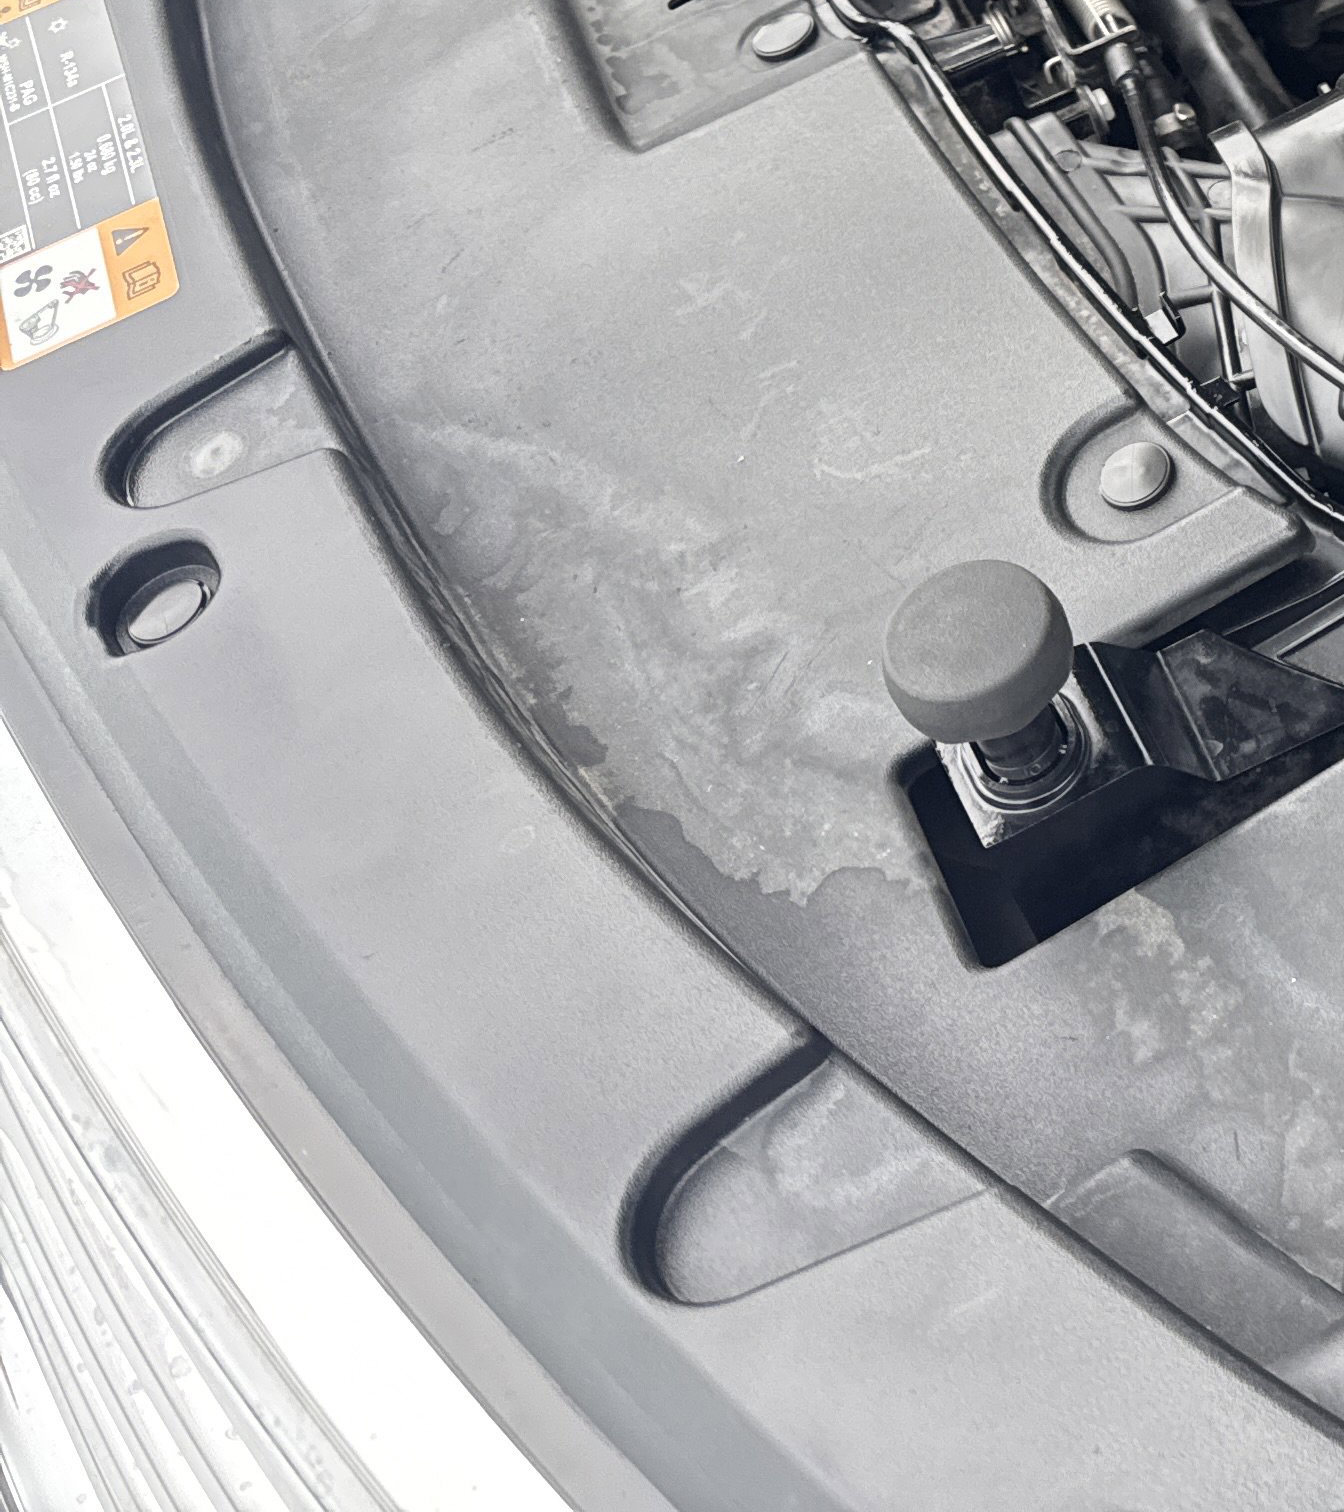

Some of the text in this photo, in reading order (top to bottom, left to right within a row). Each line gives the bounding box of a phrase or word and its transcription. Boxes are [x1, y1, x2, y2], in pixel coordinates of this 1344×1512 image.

[60, 50, 80, 88] R-134a
[19, 80, 38, 106] PAG
[118, 114, 135, 139] 2.0L
